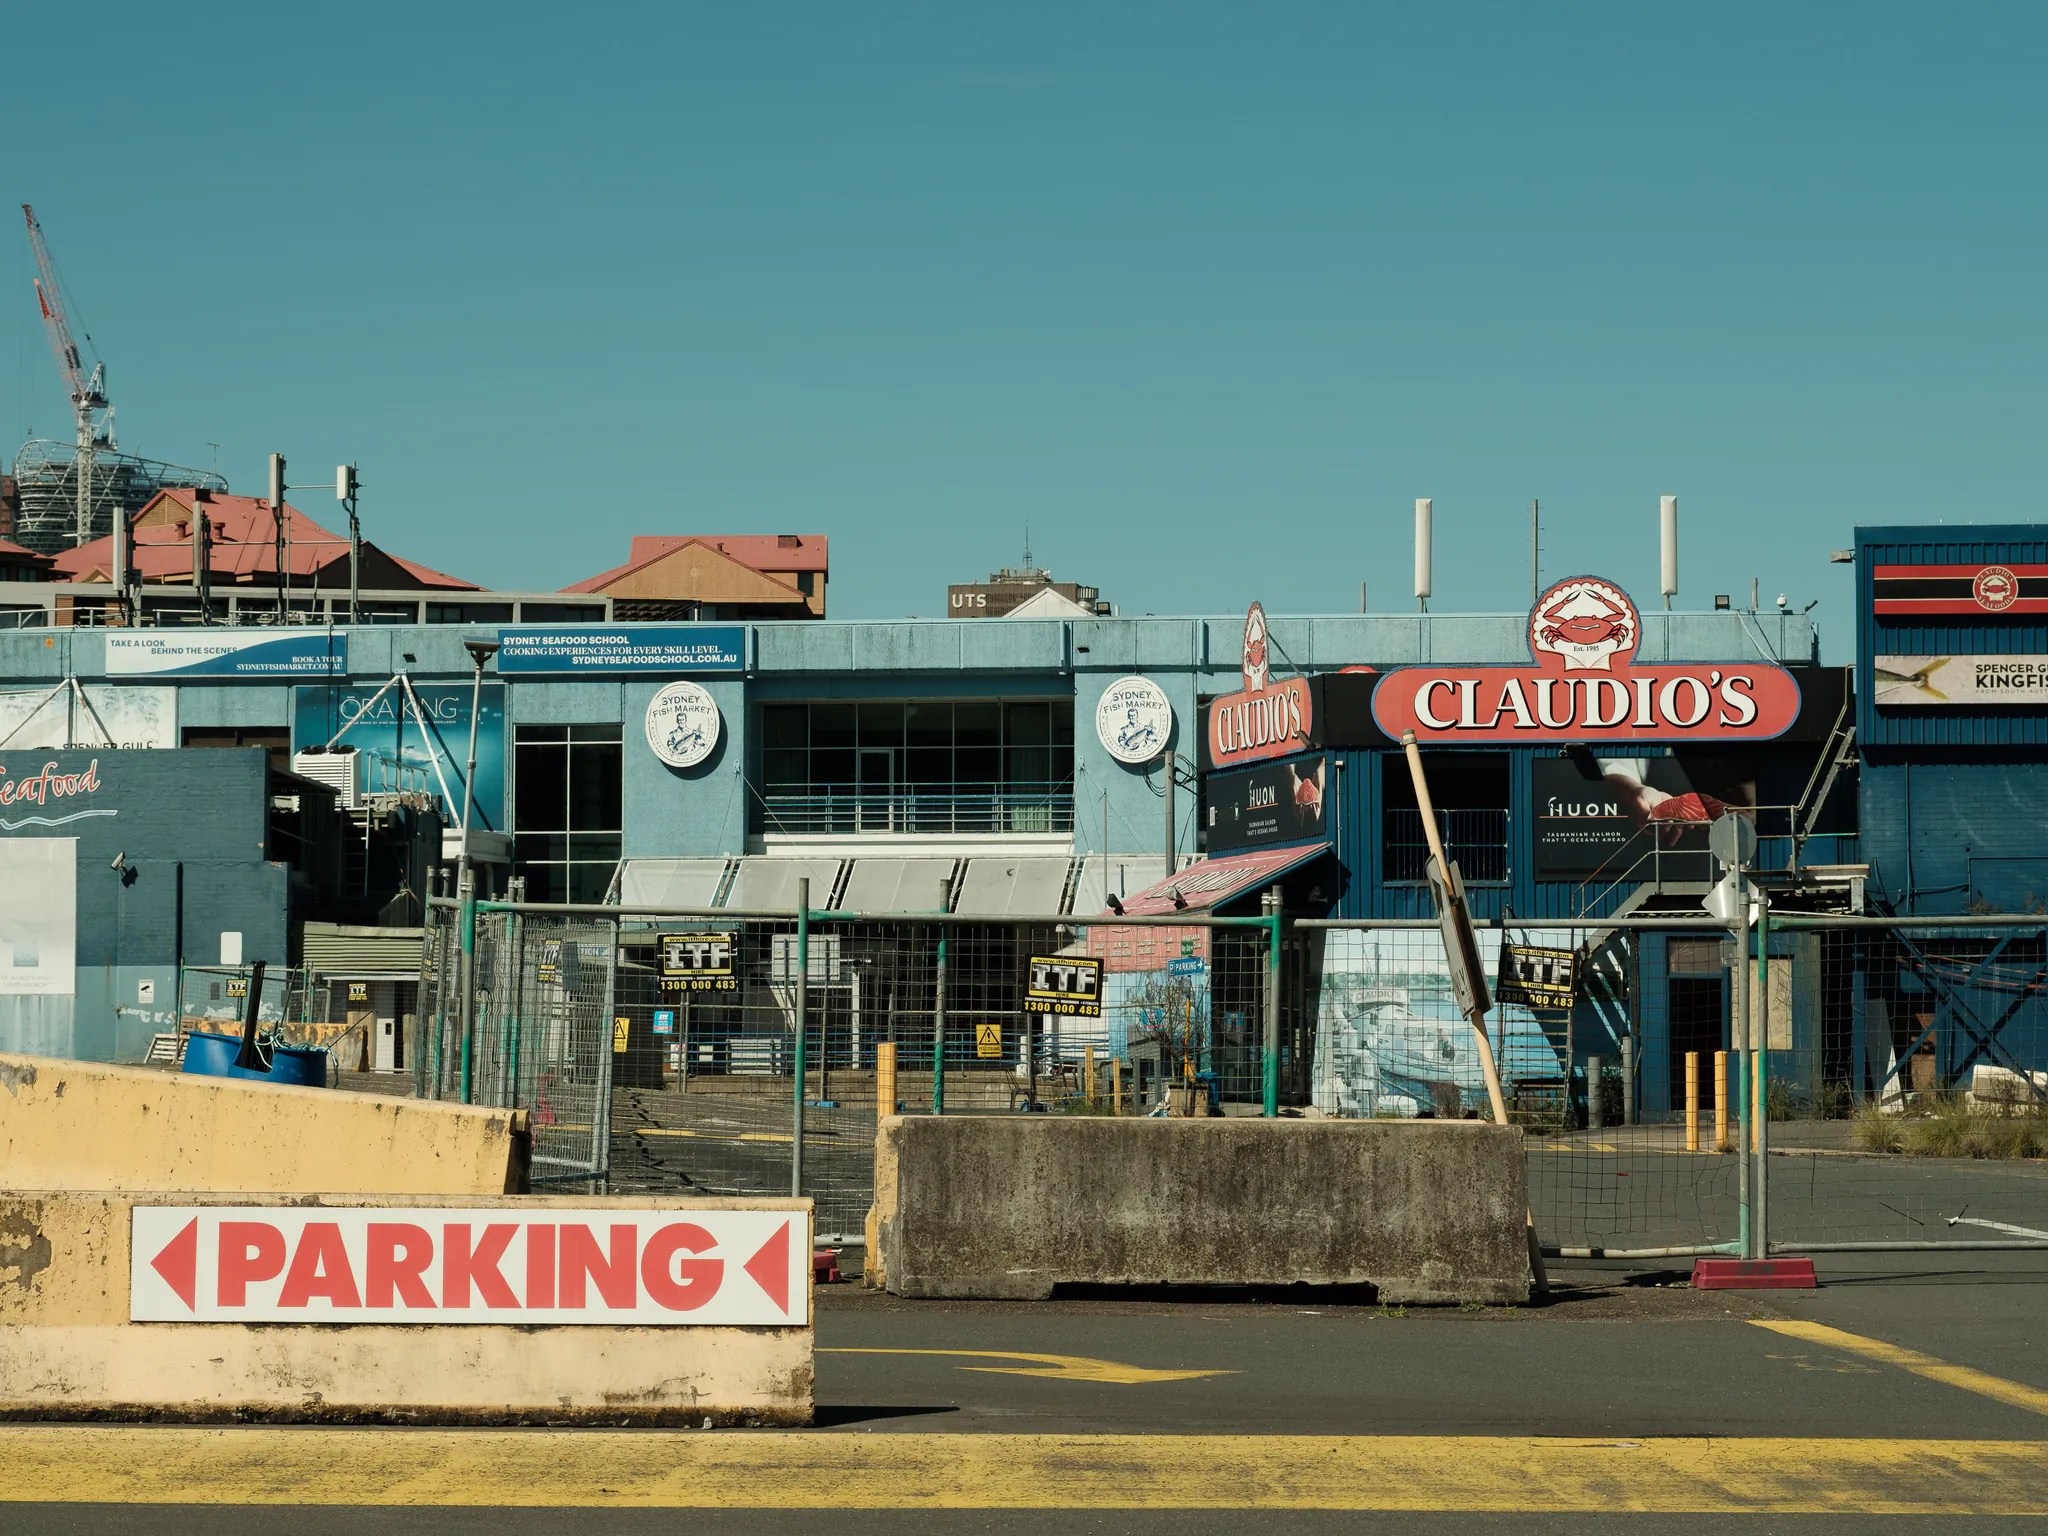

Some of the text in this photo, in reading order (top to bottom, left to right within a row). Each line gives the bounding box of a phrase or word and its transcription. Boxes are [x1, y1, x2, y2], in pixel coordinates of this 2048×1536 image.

[1977, 568, 2015, 584] CLAUDIO'S
[952, 594, 987, 608] UTS
[1977, 595, 2014, 609] SEAFOODS
[503, 636, 630, 645] SYDNEY SEAFOOD SCHOOL
[151, 646, 238, 655] BEHIND THE SCENES
[503, 645, 723, 656] COOKING EXPERIENCES FOR EVERY SKILL LEVEL.
[572, 654, 737, 665] SYDNEYSEAFOODSCHOOL.COM.AU
[236, 663, 343, 671] SYDNEYFISHMARKET.COMAU
[1975, 664, 2034, 673] SPENCER
[662, 695, 701, 706] SYDNEY
[1112, 690, 1152, 701] SYDNEY
[1413, 671, 1758, 729] CLAUDIO'S
[402, 697, 458, 719] KNG
[653, 705, 711, 718] FISH MARKET
[1103, 700, 1163, 714] FISH MARKET
[1217, 686, 1301, 753] CLAUDIO'S
[1249, 780, 1276, 807] HUON
[1548, 797, 1618, 816] HUON
[666, 943, 729, 969] ITF
[1037, 958, 1094, 966] www.itfhire.com
[1175, 962, 1197, 971] PARKING
[660, 980, 736, 990] 1300 000 483
[1032, 964, 1096, 993] ITF
[1499, 991, 1525, 1002] 1300
[1529, 994, 1549, 1005] 000
[1553, 997, 1573, 1008] 483
[1024, 1001, 1051, 1012] 1300
[1054, 1004, 1075, 1013] 000
[1078, 1005, 1099, 1015] 483
[217, 1222, 724, 1312] PARKING
